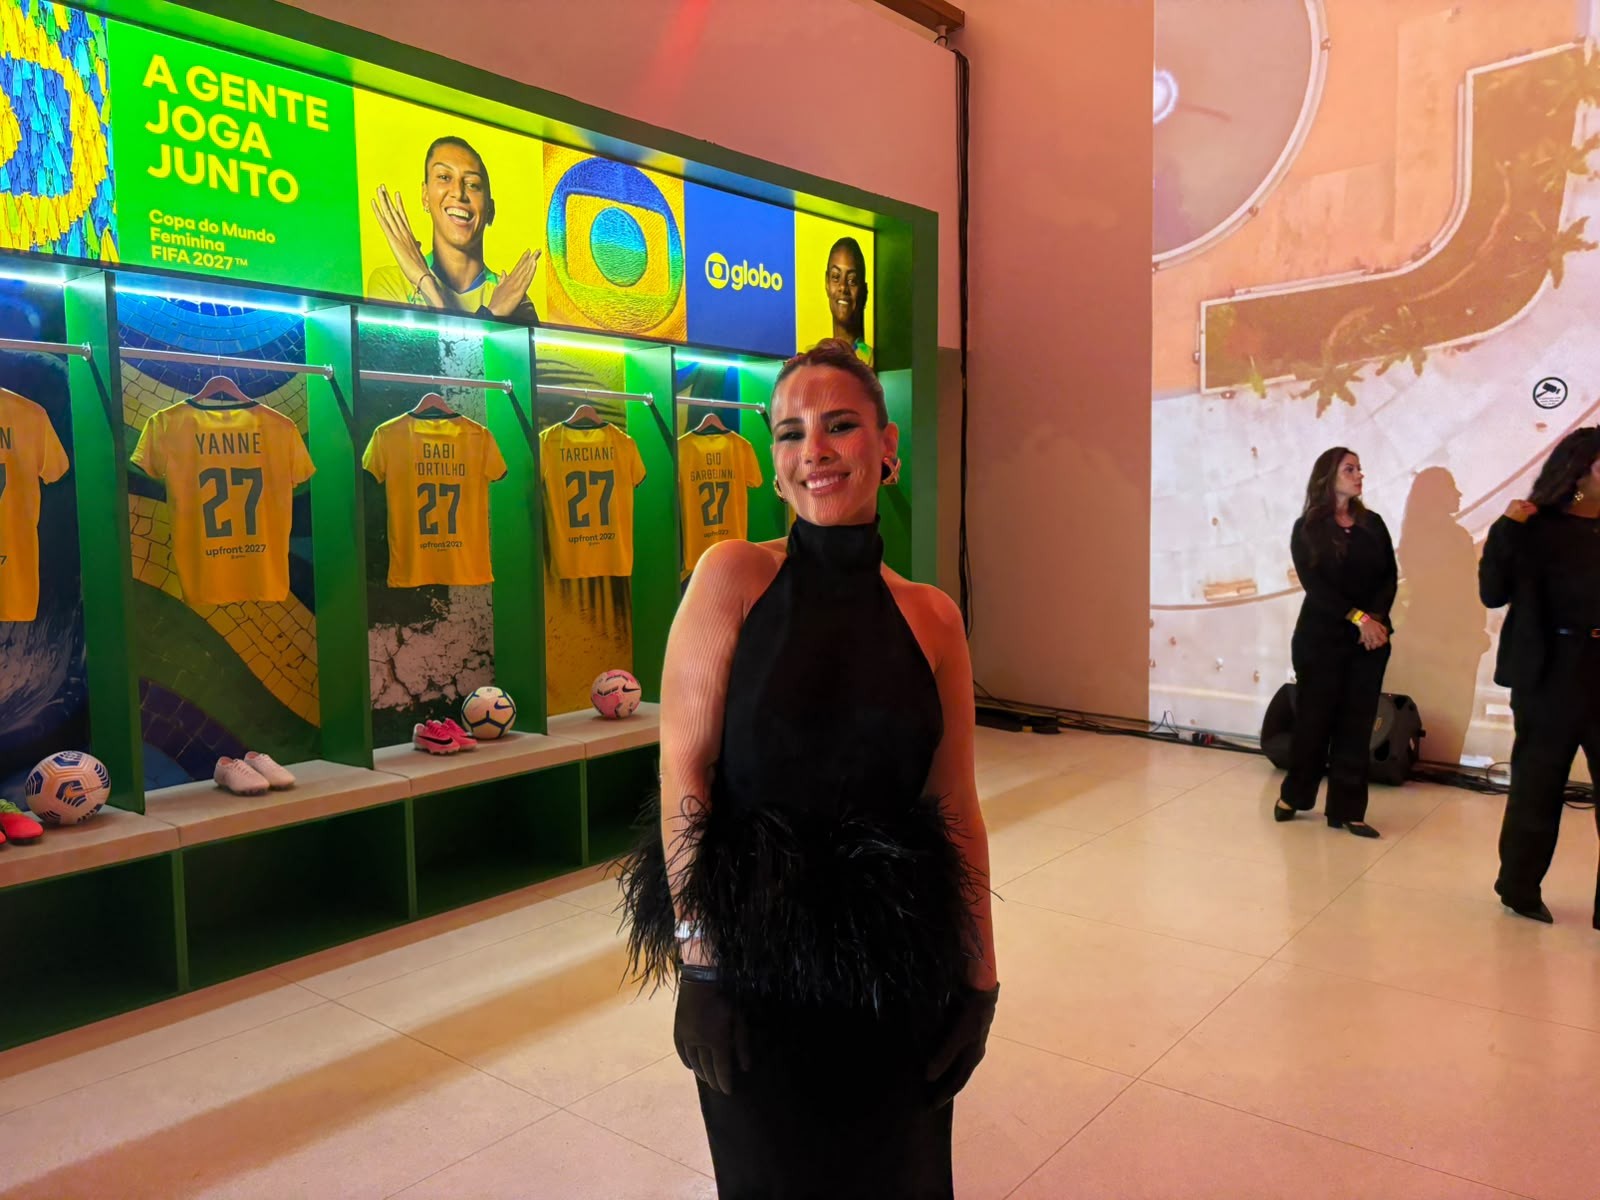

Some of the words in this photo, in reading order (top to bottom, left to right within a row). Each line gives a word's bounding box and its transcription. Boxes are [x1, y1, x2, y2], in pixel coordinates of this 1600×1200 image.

[143, 54, 178, 94] A
[186, 66, 329, 131] GENTE
[145, 100, 272, 158] JOGA
[147, 144, 299, 203] JUNTO
[149, 209, 195, 231] Copa
[198, 218, 219, 234] do
[222, 222, 276, 244] Mundo
[150, 227, 225, 252] Feminina
[151, 245, 190, 264] FIFA
[731, 260, 783, 291] globo
[195, 432, 262, 455] YANNE
[423, 443, 455, 459] GABI
[705, 452, 721, 465] GIO
[415, 462, 466, 477] ORTILHO
[198, 466, 264, 538] 27
[417, 482, 461, 535] 27
[565, 469, 615, 528] 27
[698, 481, 730, 526] 27
[205, 545, 243, 558] upfront
[244, 543, 267, 553] 2027
[568, 534, 599, 545] upfront
[599, 533, 616, 541] 2027
